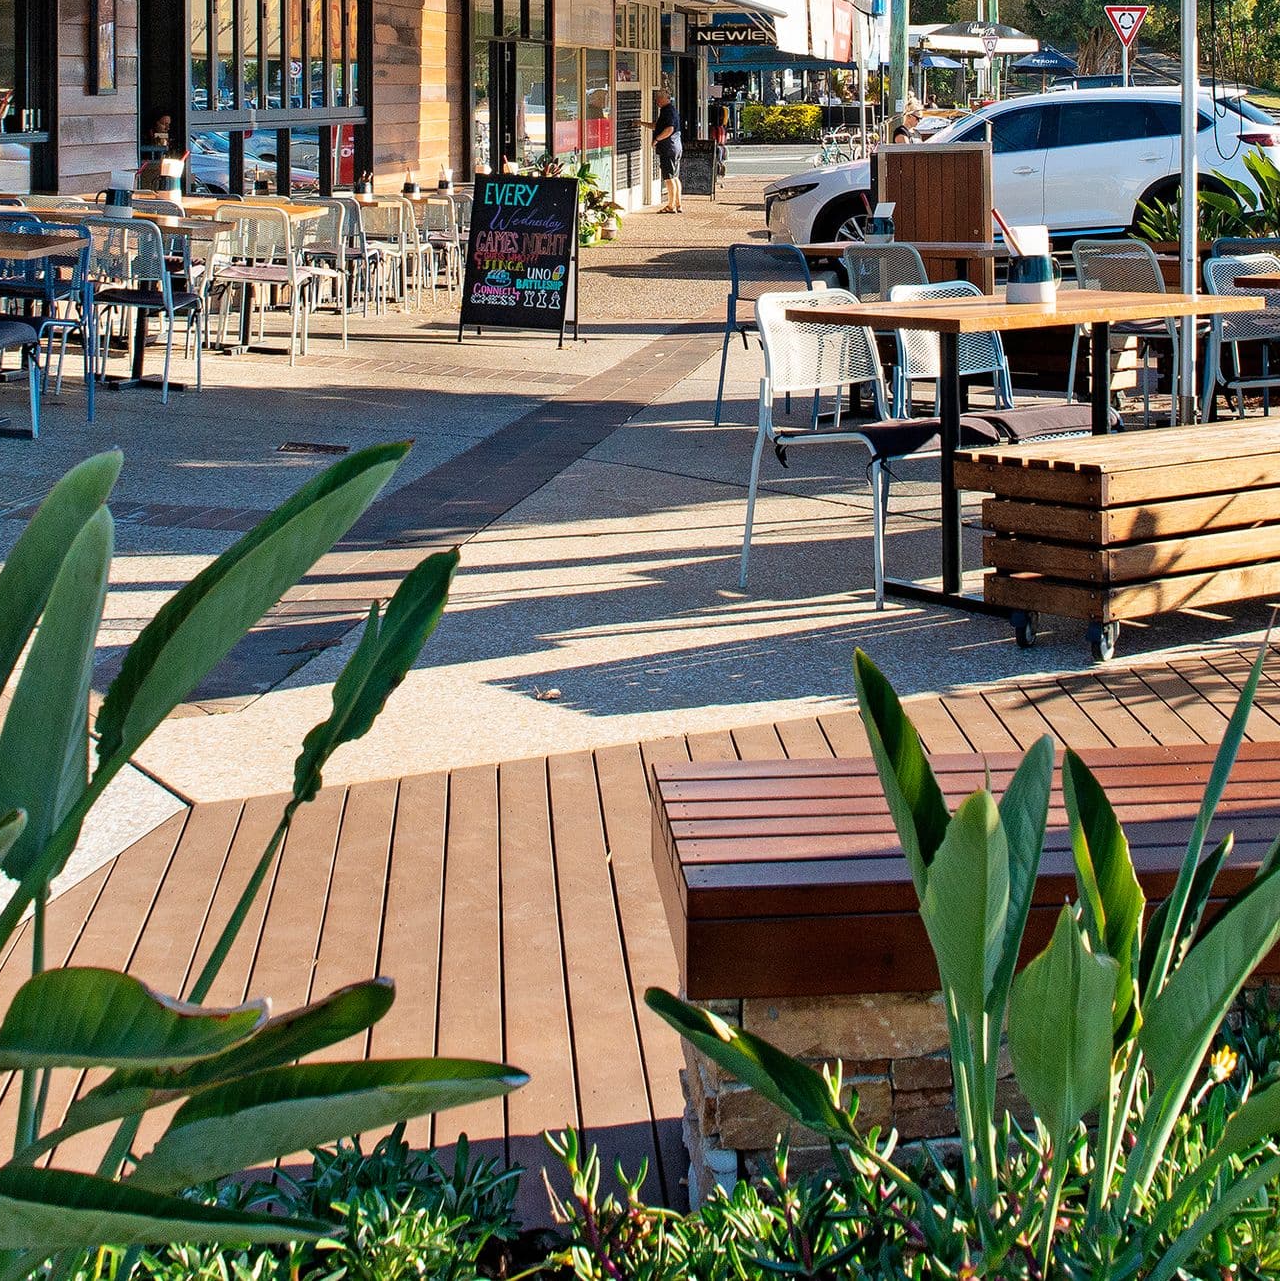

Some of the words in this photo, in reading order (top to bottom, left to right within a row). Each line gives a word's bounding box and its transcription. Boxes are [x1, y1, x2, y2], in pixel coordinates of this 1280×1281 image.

[484, 182, 539, 206] EVERY
[476, 231, 520, 254] GAMES
[522, 233, 568, 256] NIGHT
[527, 267, 552, 280] UNO
[516, 278, 564, 291] BATTLESHIP
